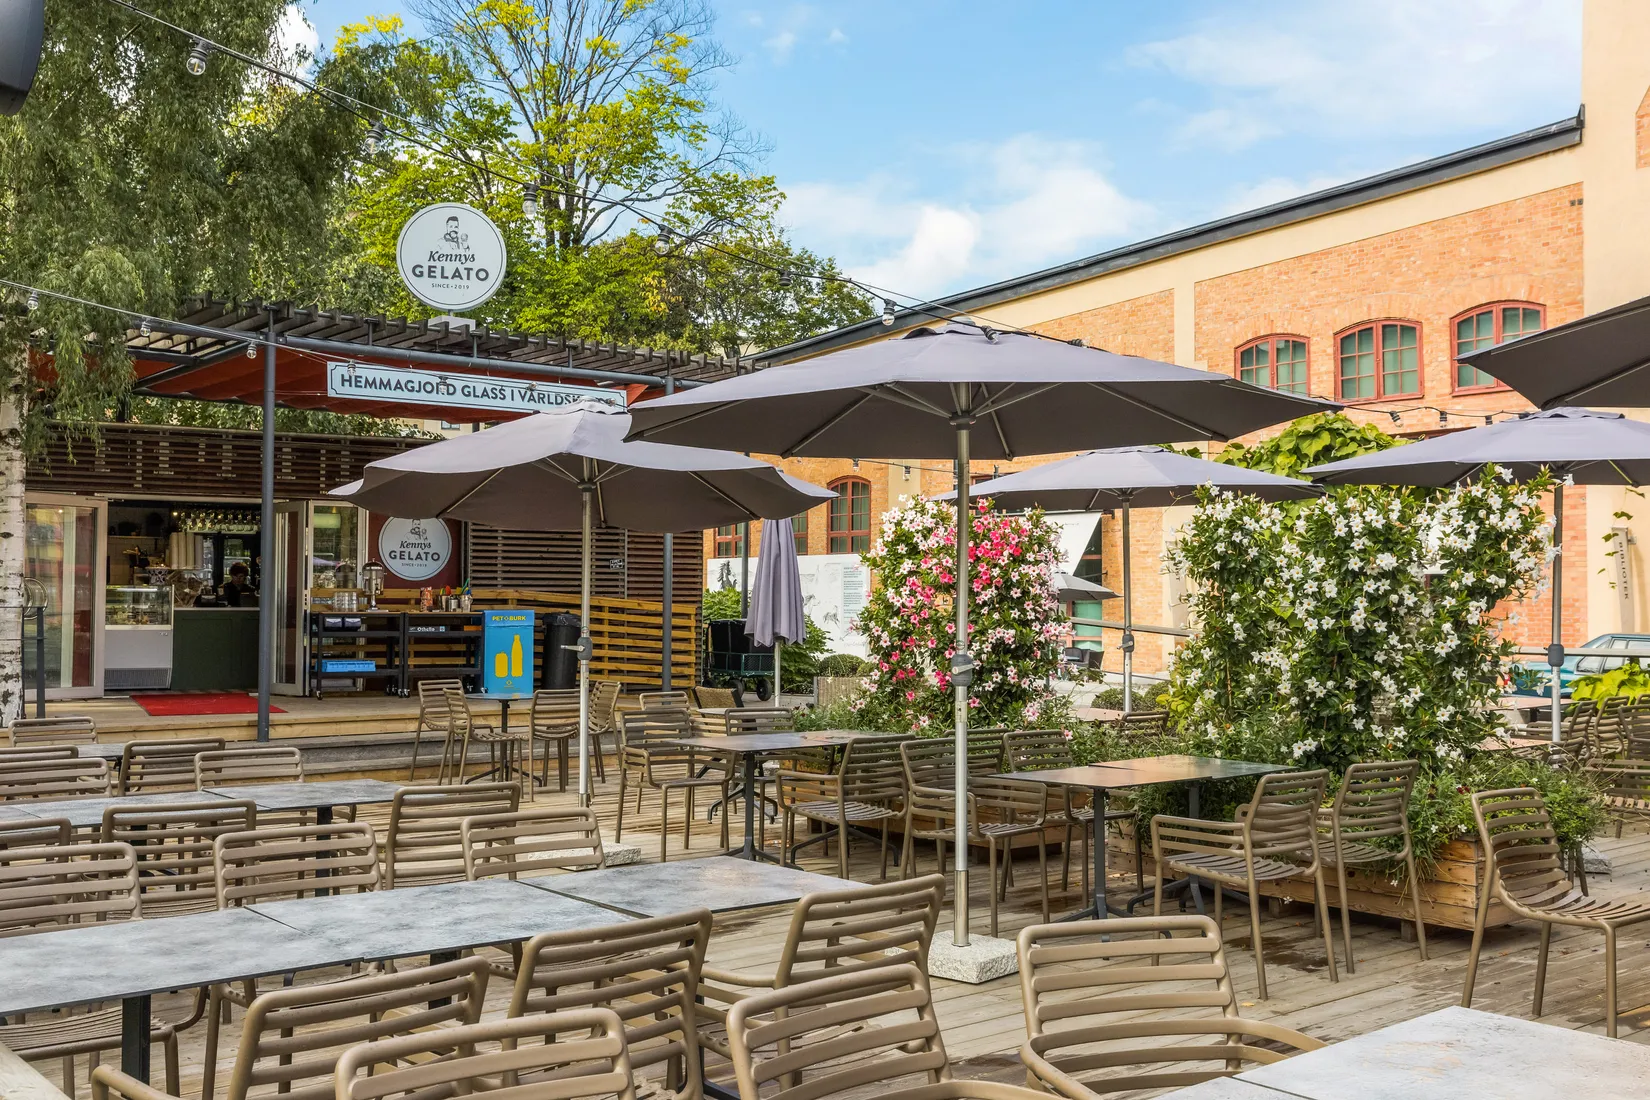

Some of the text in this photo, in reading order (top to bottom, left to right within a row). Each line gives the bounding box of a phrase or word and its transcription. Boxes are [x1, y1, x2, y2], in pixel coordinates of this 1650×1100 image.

[428, 251, 476, 265] Kennys
[411, 264, 490, 282] GELATO
[461, 384, 507, 401] GLASS
[511, 388, 515, 402] I
[399, 540, 432, 550] Kennys
[388, 550, 441, 562] GELATO
